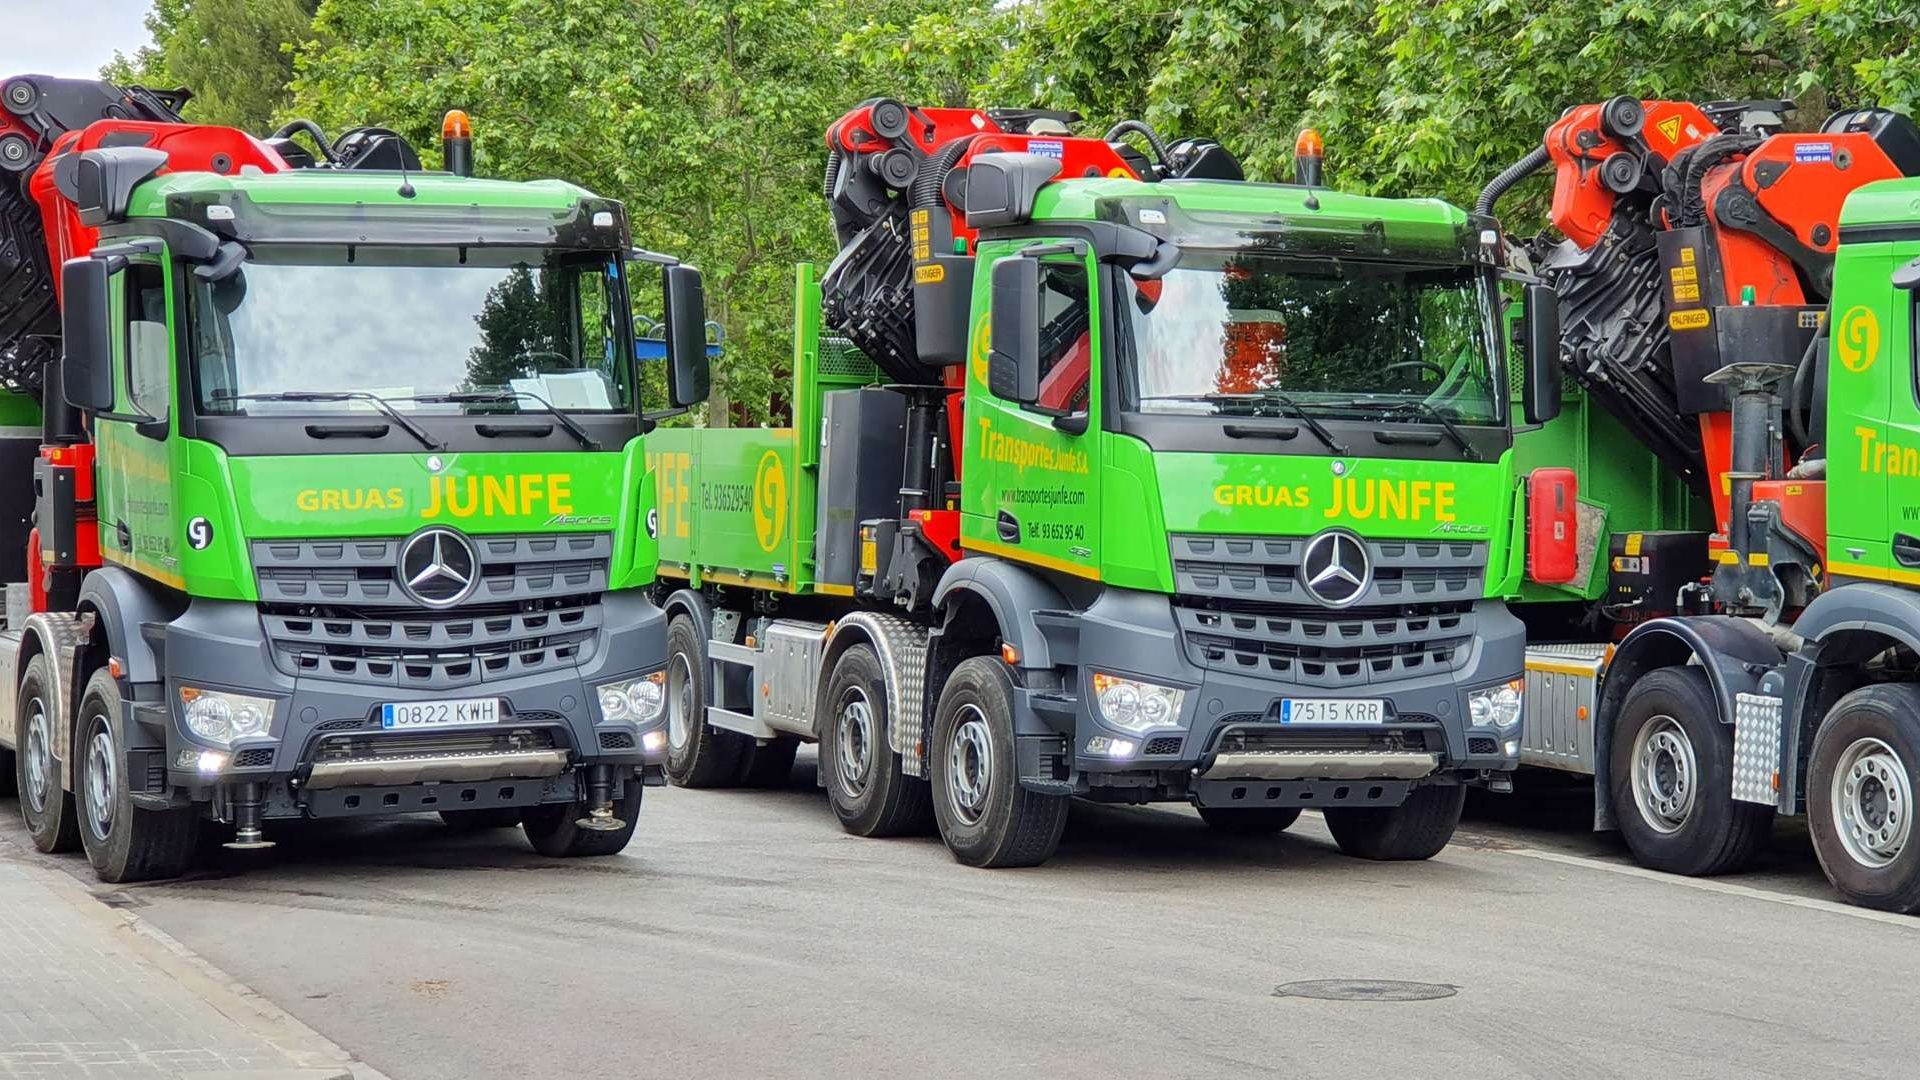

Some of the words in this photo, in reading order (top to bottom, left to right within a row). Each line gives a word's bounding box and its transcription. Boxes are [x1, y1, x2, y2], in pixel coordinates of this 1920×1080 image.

[979, 416, 1056, 474] Transportes
[297, 488, 404, 511] GRUAS
[420, 474, 573, 518] JUNFE
[1214, 485, 1310, 507] GRUAS
[1324, 478, 1456, 521] JUNFE
[1042, 523, 1050, 539] 93
[1051, 523, 1064, 540] 652
[1064, 524, 1074, 540] 95
[1074, 525, 1084, 541] 40
[398, 705, 448, 724] 0822
[456, 702, 493, 721] KWH
[1293, 703, 1338, 721] 7515
[1345, 703, 1378, 721] KRR
